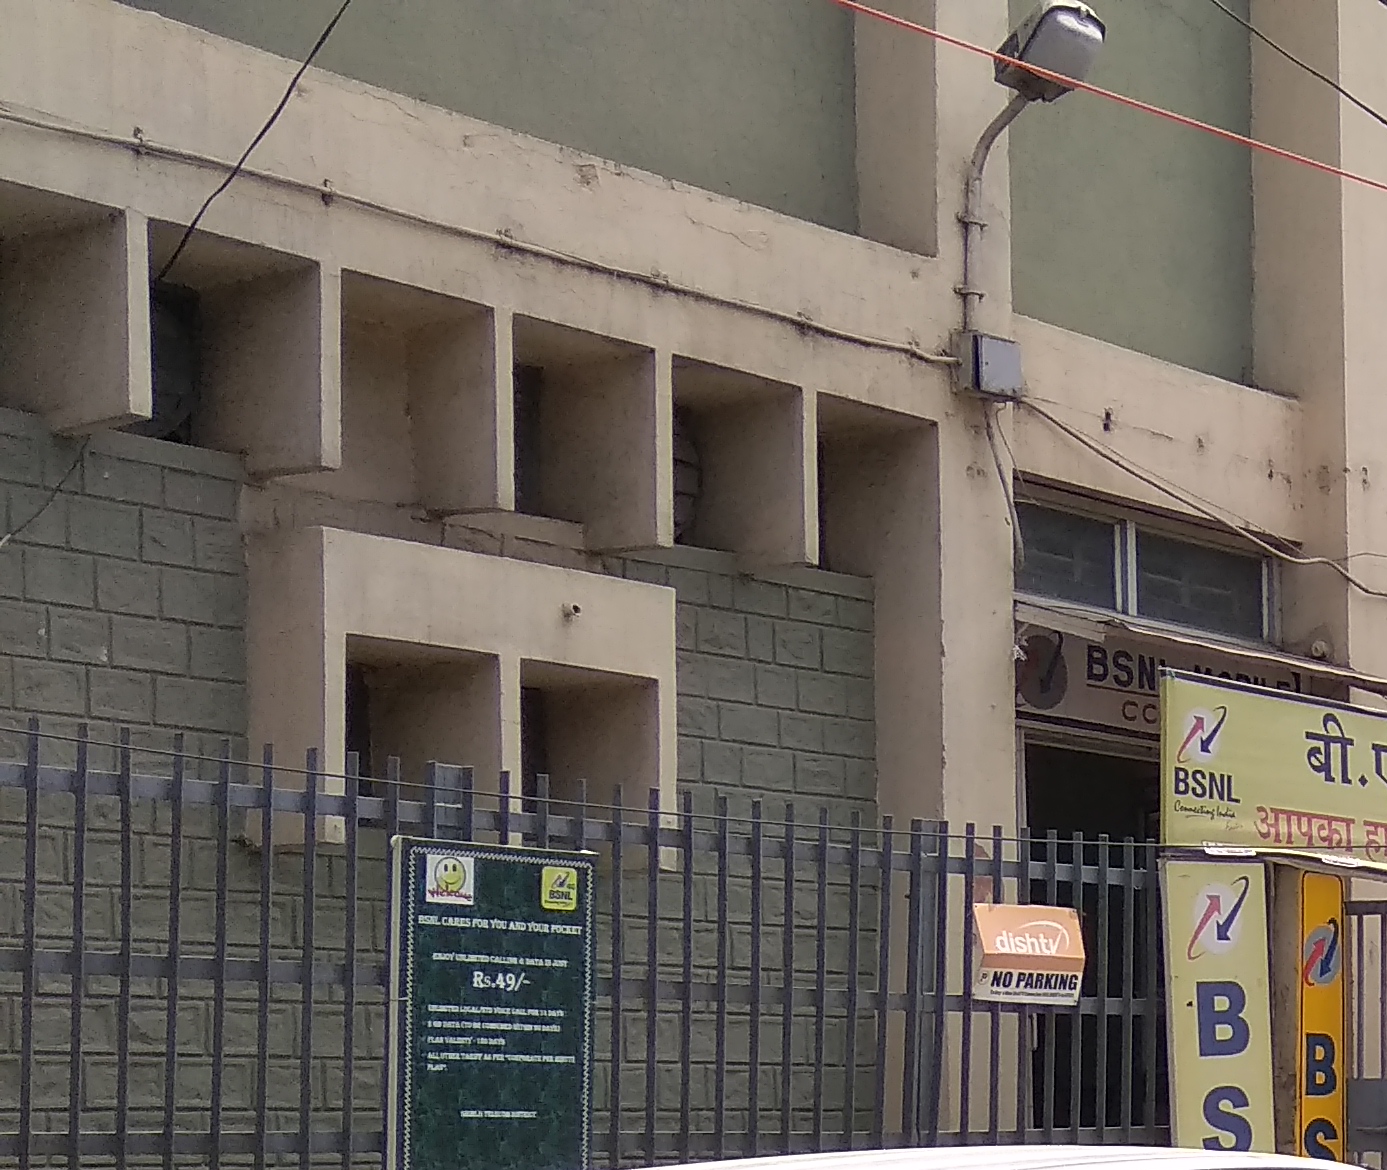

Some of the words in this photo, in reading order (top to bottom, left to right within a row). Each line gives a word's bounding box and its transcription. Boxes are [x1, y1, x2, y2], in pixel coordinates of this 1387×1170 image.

[1086, 644, 1166, 694] BSN
[1173, 766, 1241, 804] BSNL
[1254, 805, 1356, 852] आपका
[491, 920, 508, 931] YOU
[990, 970, 1014, 989] NO
[1015, 972, 1079, 992] PARKING
